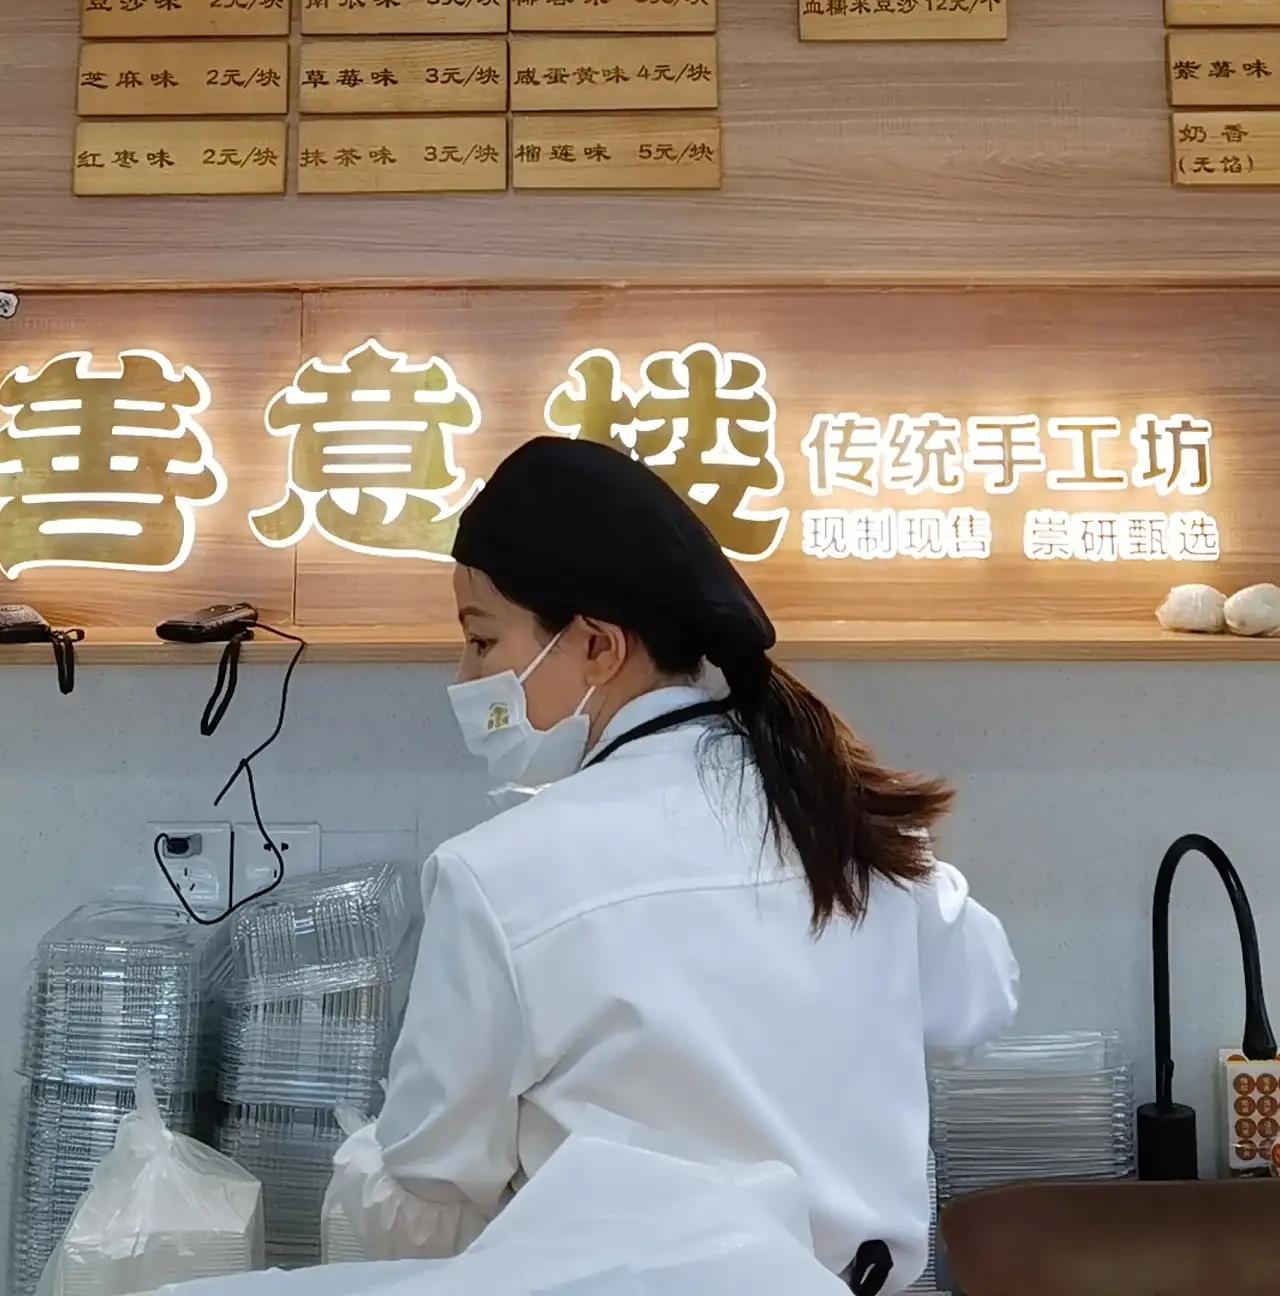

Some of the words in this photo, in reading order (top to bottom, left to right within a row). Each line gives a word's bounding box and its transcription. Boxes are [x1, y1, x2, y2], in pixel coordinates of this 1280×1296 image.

[81, 70, 179, 88] 芝麻味
[206, 68, 280, 88] 2元/块
[302, 69, 398, 88] 草莓味
[426, 66, 500, 87] 3元/块
[514, 65, 630, 85] 咸蛋黄味
[636, 63, 711, 83] 4元/块
[1173, 59, 1272, 80] 紫薯味
[1179, 124, 1249, 143] 奶香
[77, 149, 175, 168] 红枣味
[202, 146, 278, 168] 2元/块
[301, 146, 396, 167] 抹茶味
[424, 144, 498, 164] 3元/块
[515, 142, 611, 163] 榴莲味
[638, 142, 714, 163] 5元/块
[802, 413, 1213, 496] 传统手工坊
[803, 508, 991, 560] 现制现售
[1025, 510, 1220, 561] 崇研甄选
